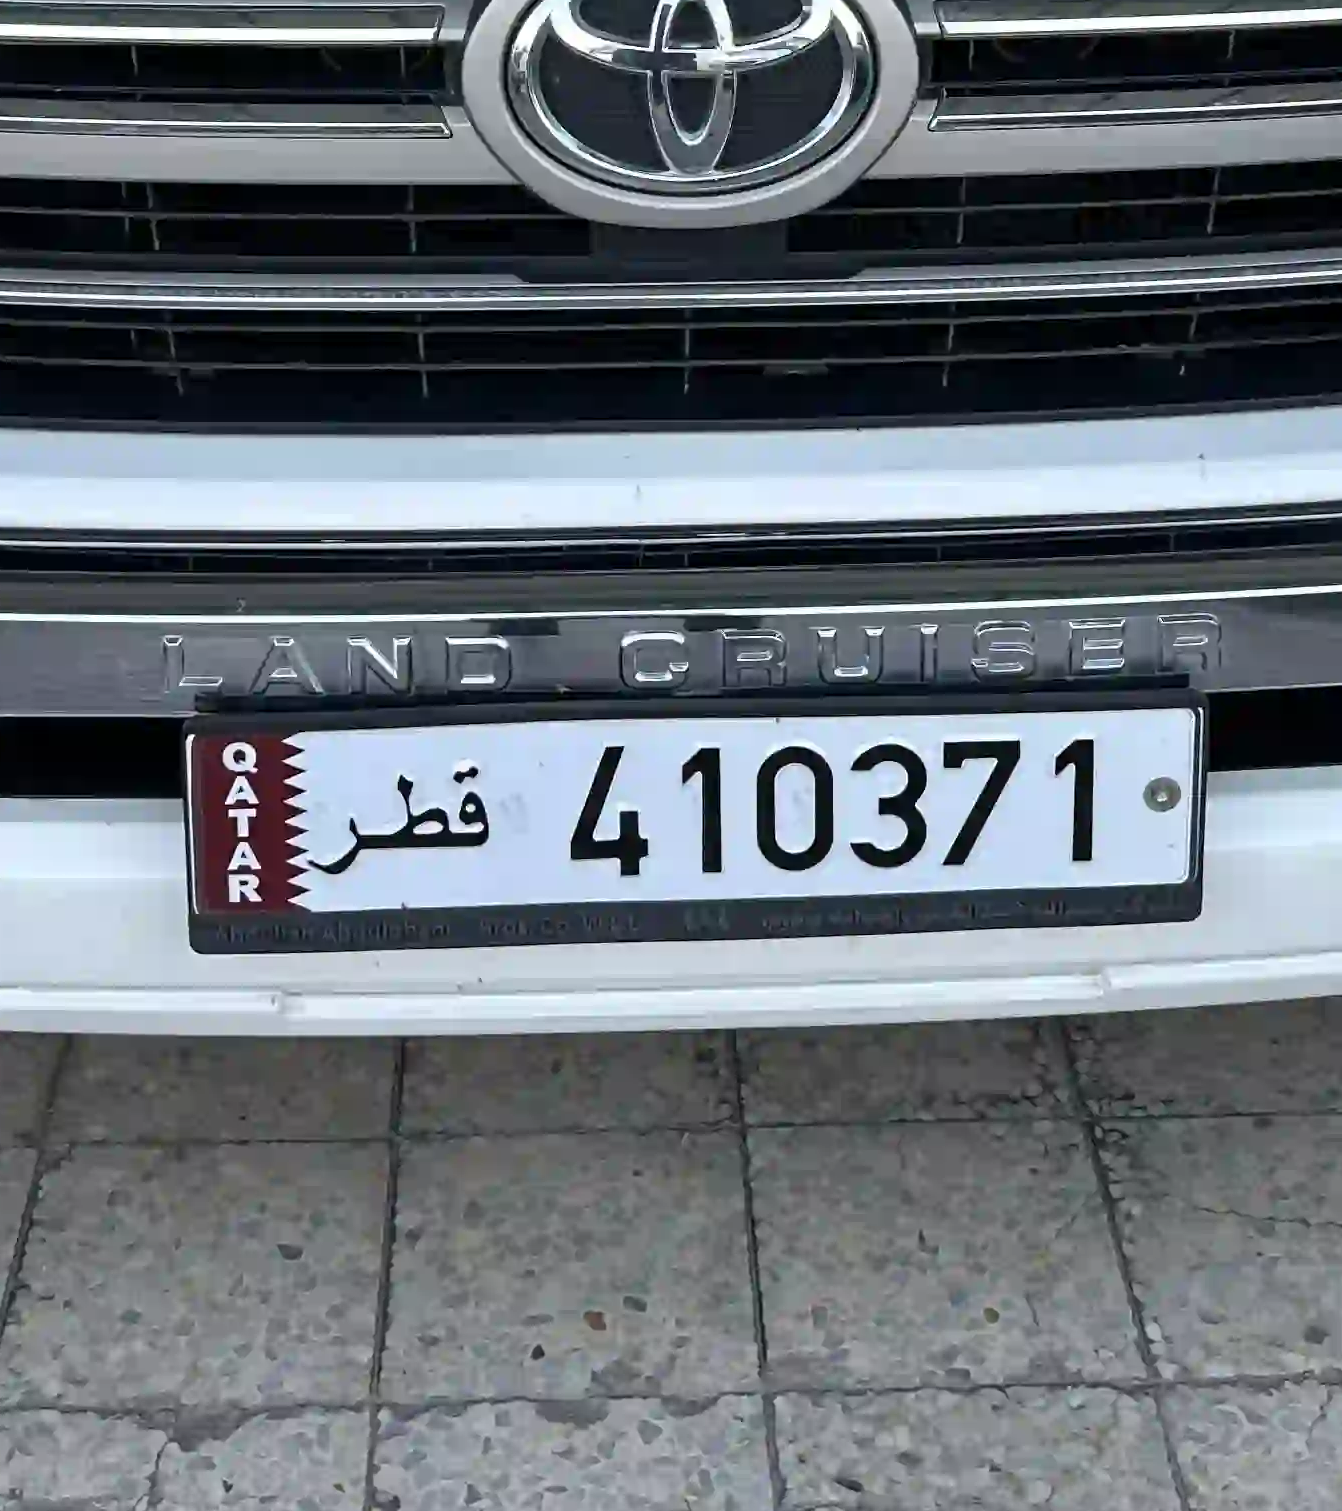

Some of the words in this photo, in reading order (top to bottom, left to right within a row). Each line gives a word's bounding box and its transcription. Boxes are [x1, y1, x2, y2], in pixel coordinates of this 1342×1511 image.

[161, 633, 514, 695] LAND
[618, 613, 1224, 695] CRUISER
[221, 741, 264, 903] QATAR
[307, 765, 490, 875] قطر
[569, 737, 1096, 877] 410371
